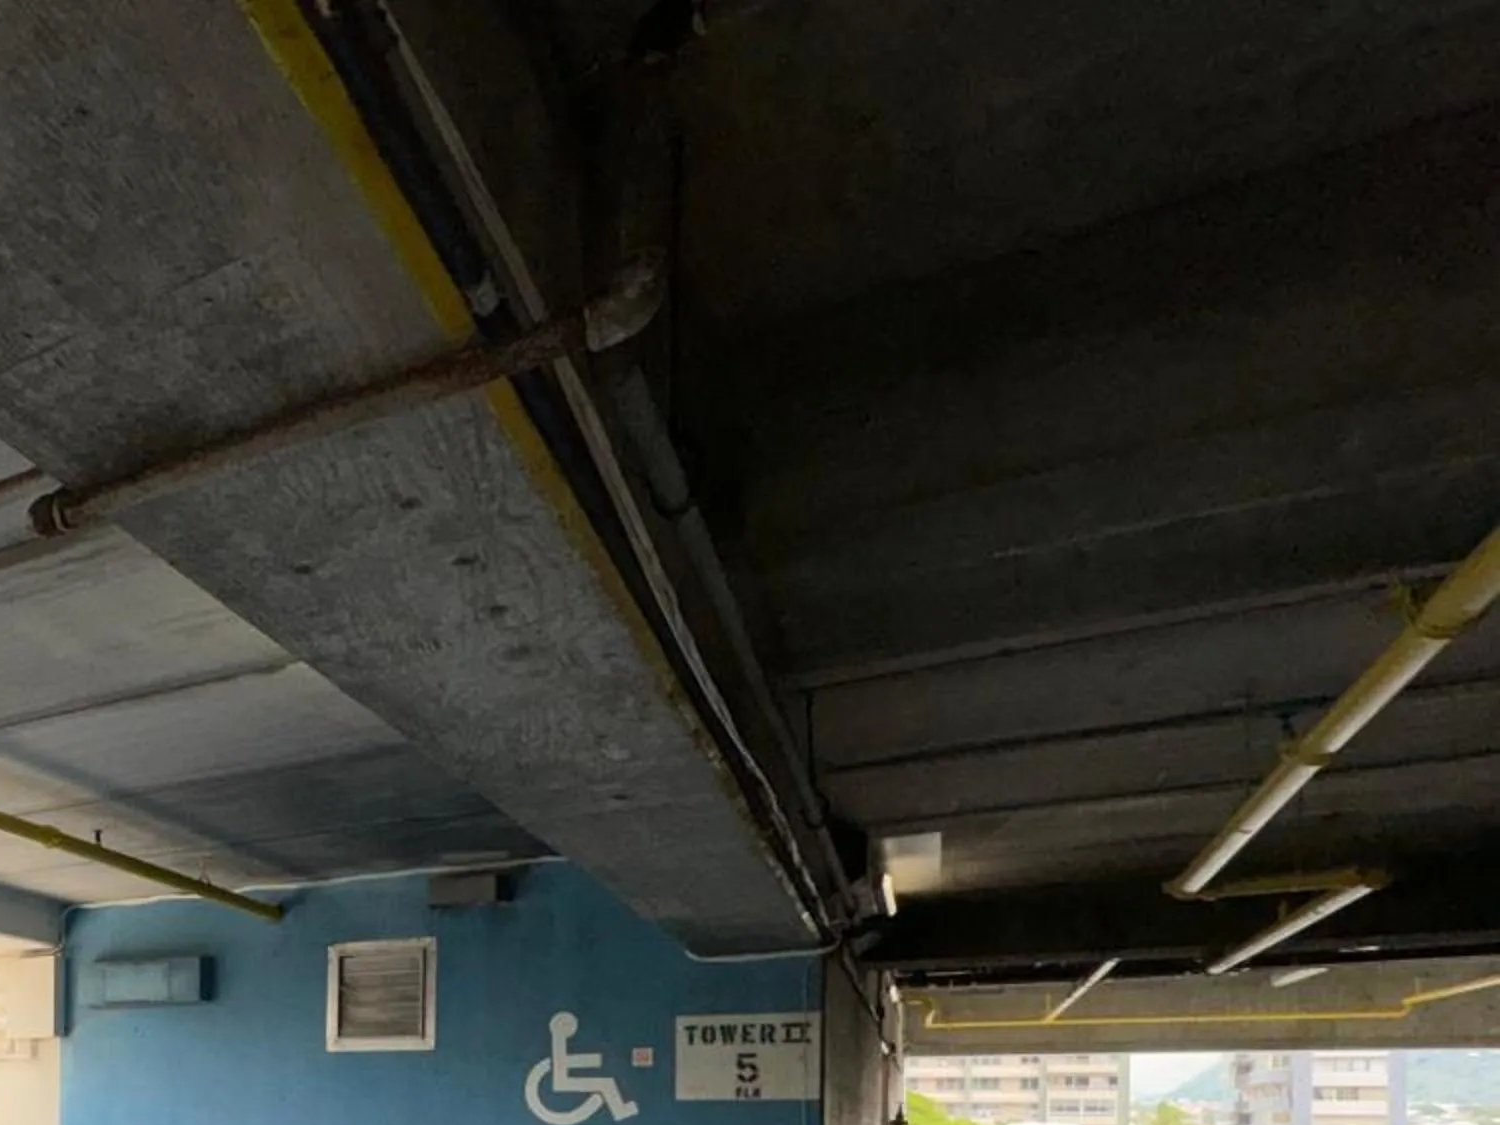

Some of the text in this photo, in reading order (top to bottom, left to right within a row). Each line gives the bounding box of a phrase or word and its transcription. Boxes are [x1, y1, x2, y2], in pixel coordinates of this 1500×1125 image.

[684, 1021, 812, 1046] TOWER II
[736, 1052, 759, 1084] 5
